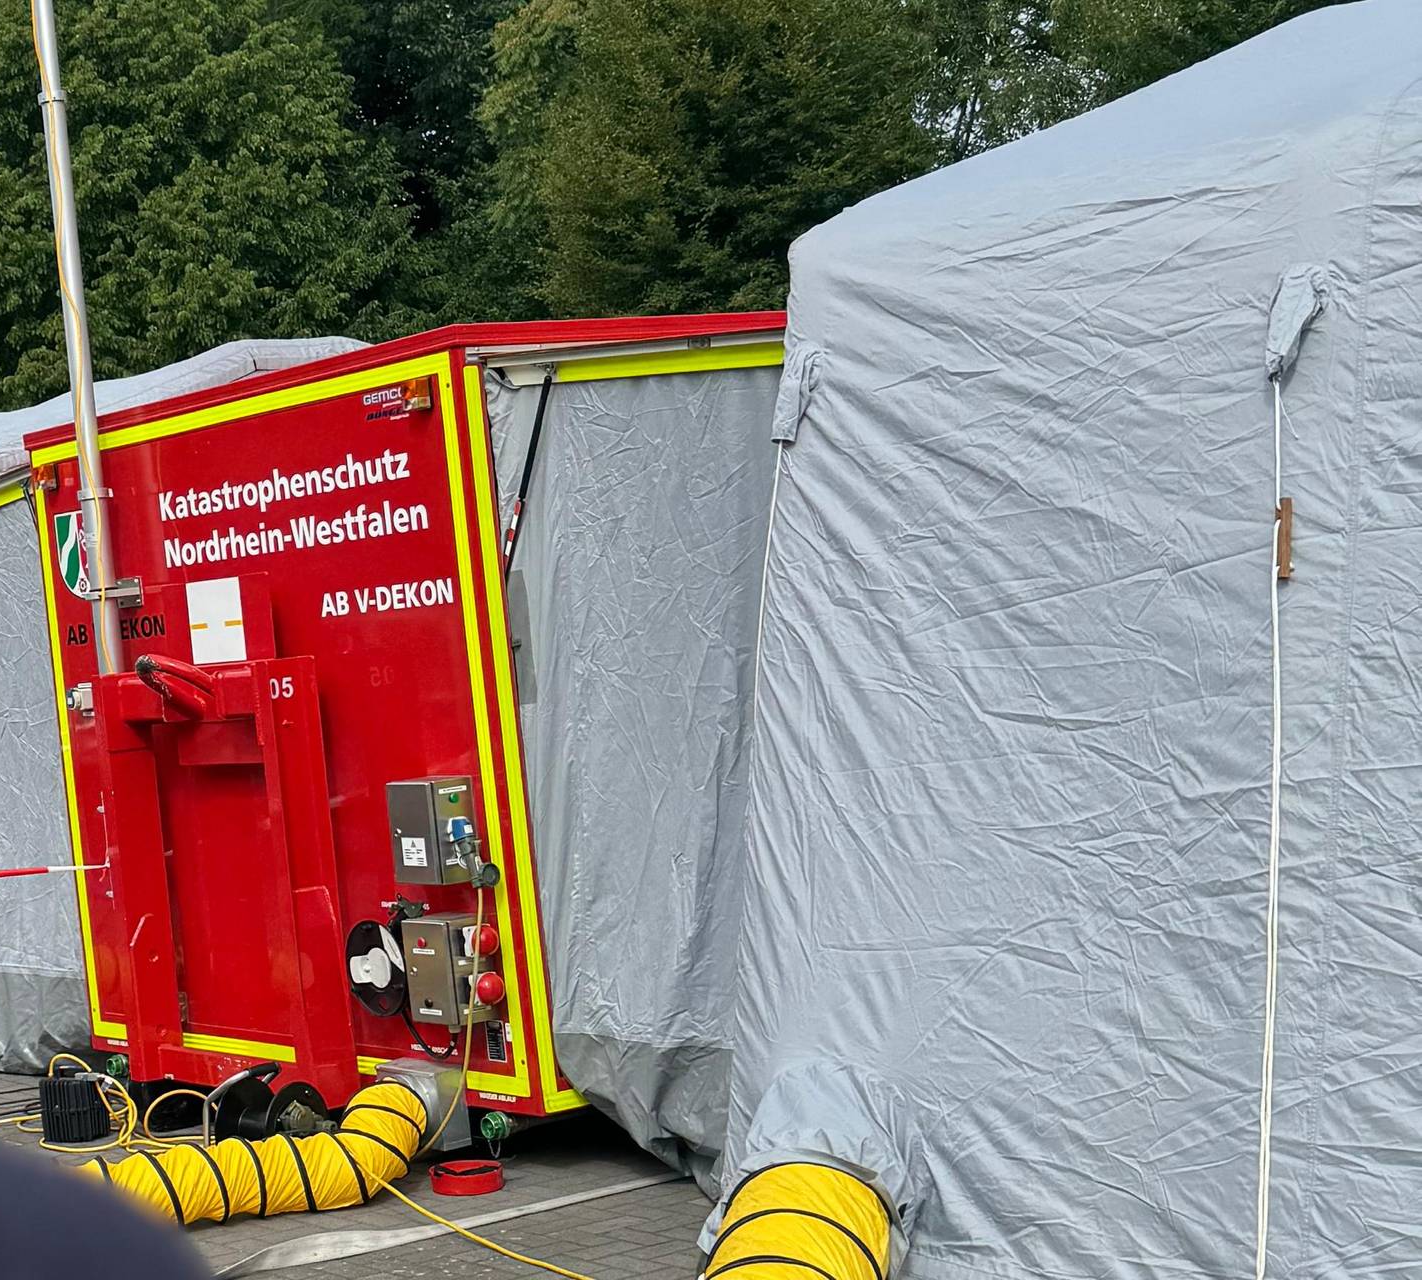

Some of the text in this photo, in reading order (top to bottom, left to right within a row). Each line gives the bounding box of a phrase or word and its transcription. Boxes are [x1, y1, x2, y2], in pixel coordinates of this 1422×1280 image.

[158, 449, 410, 521] Katastrophenschutz
[163, 500, 429, 568] Nordrhein-Westfalen
[321, 577, 454, 618] AB V-DEKON
[67, 614, 166, 646] AB EKON
[269, 676, 294, 700] 05
